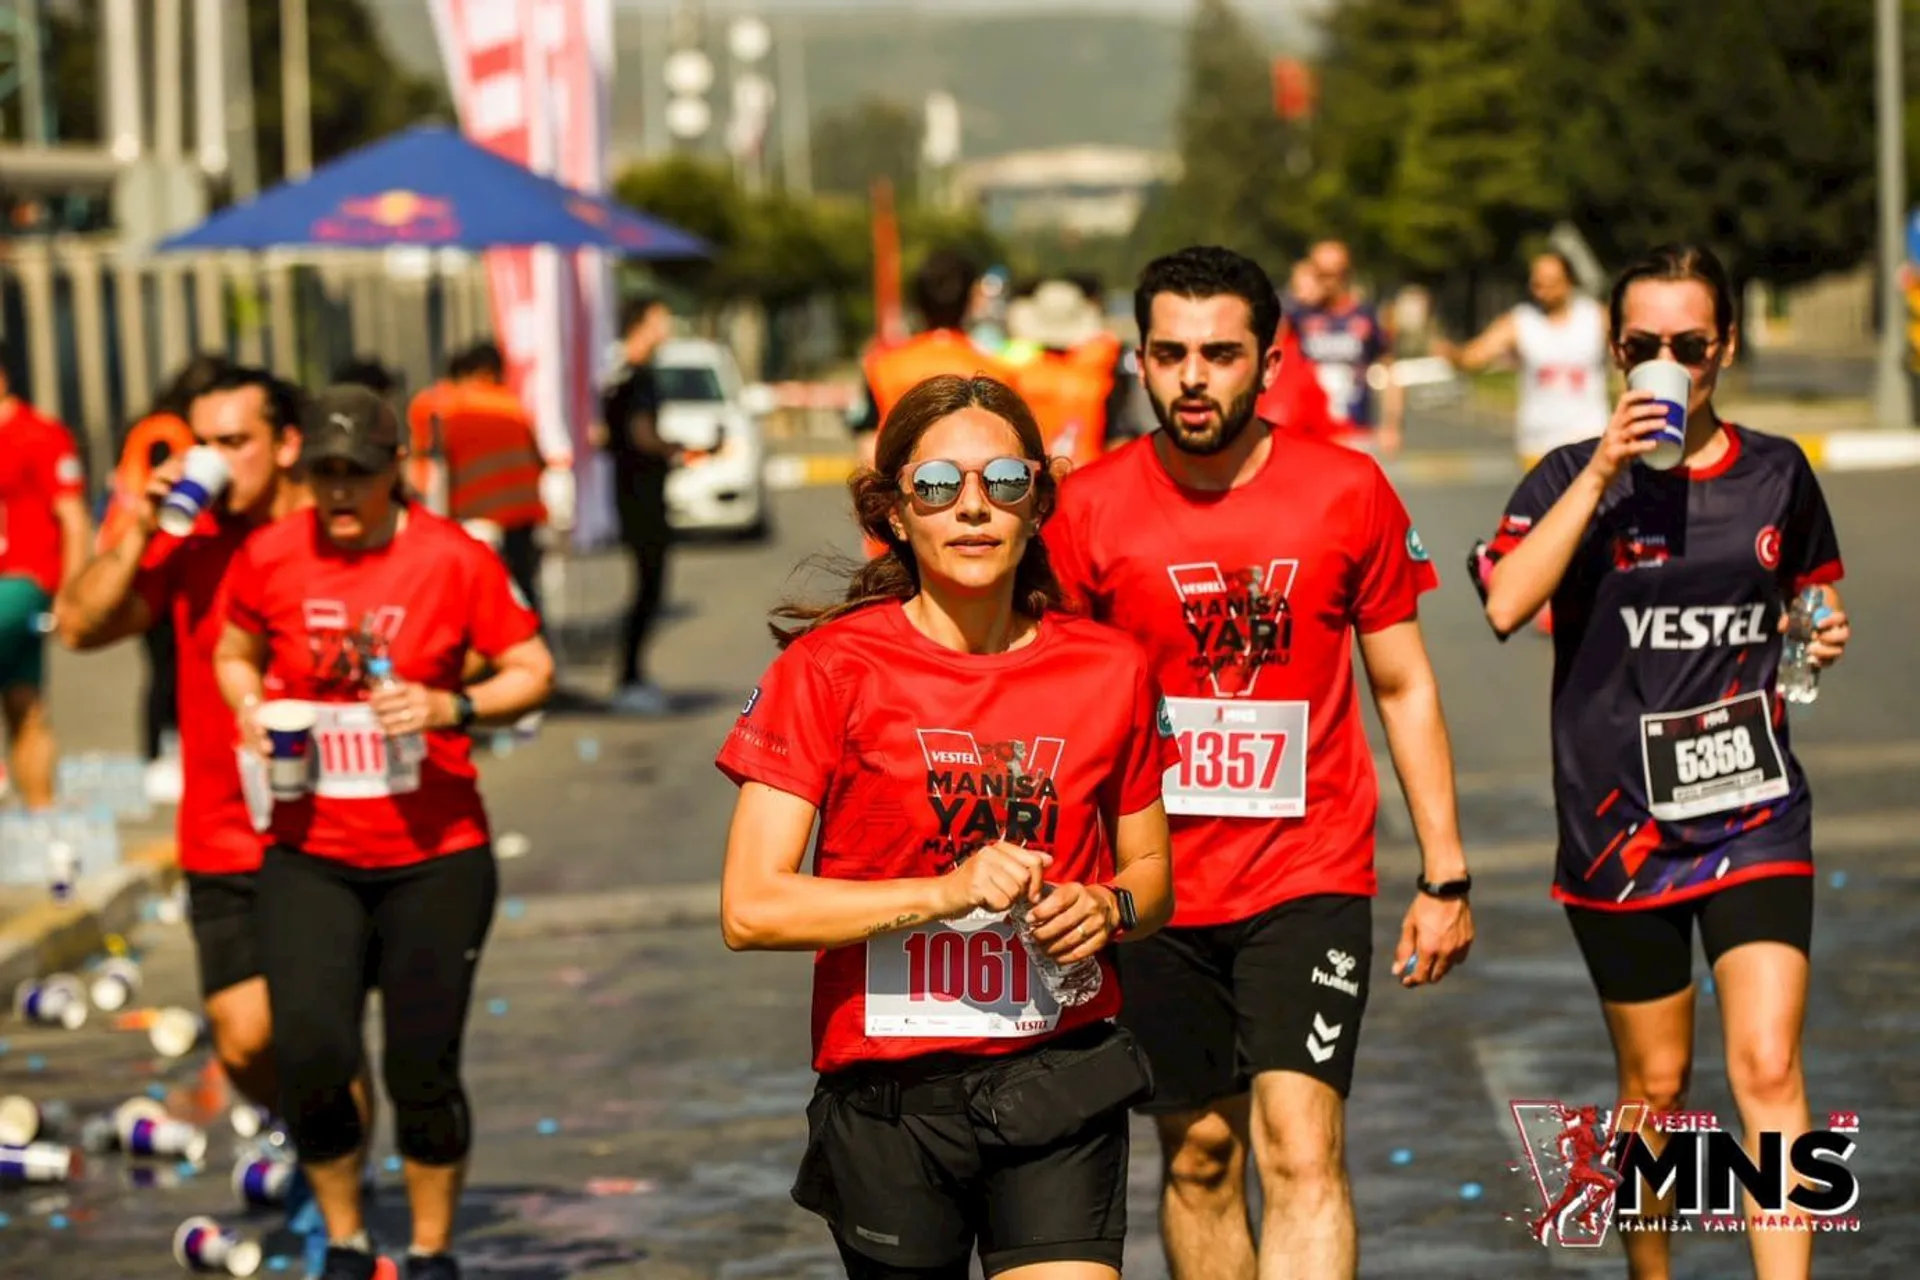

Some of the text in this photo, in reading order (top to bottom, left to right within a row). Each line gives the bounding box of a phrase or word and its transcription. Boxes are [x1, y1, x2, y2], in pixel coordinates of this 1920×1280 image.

[1185, 616, 1294, 653] YARI
[1619, 603, 1768, 649] VESTEL
[931, 750, 978, 766] VESTEL
[1177, 729, 1289, 792] 1357
[1674, 725, 1756, 784] 5358
[928, 796, 1060, 843] YARI
[904, 931, 1031, 1005] 1061
